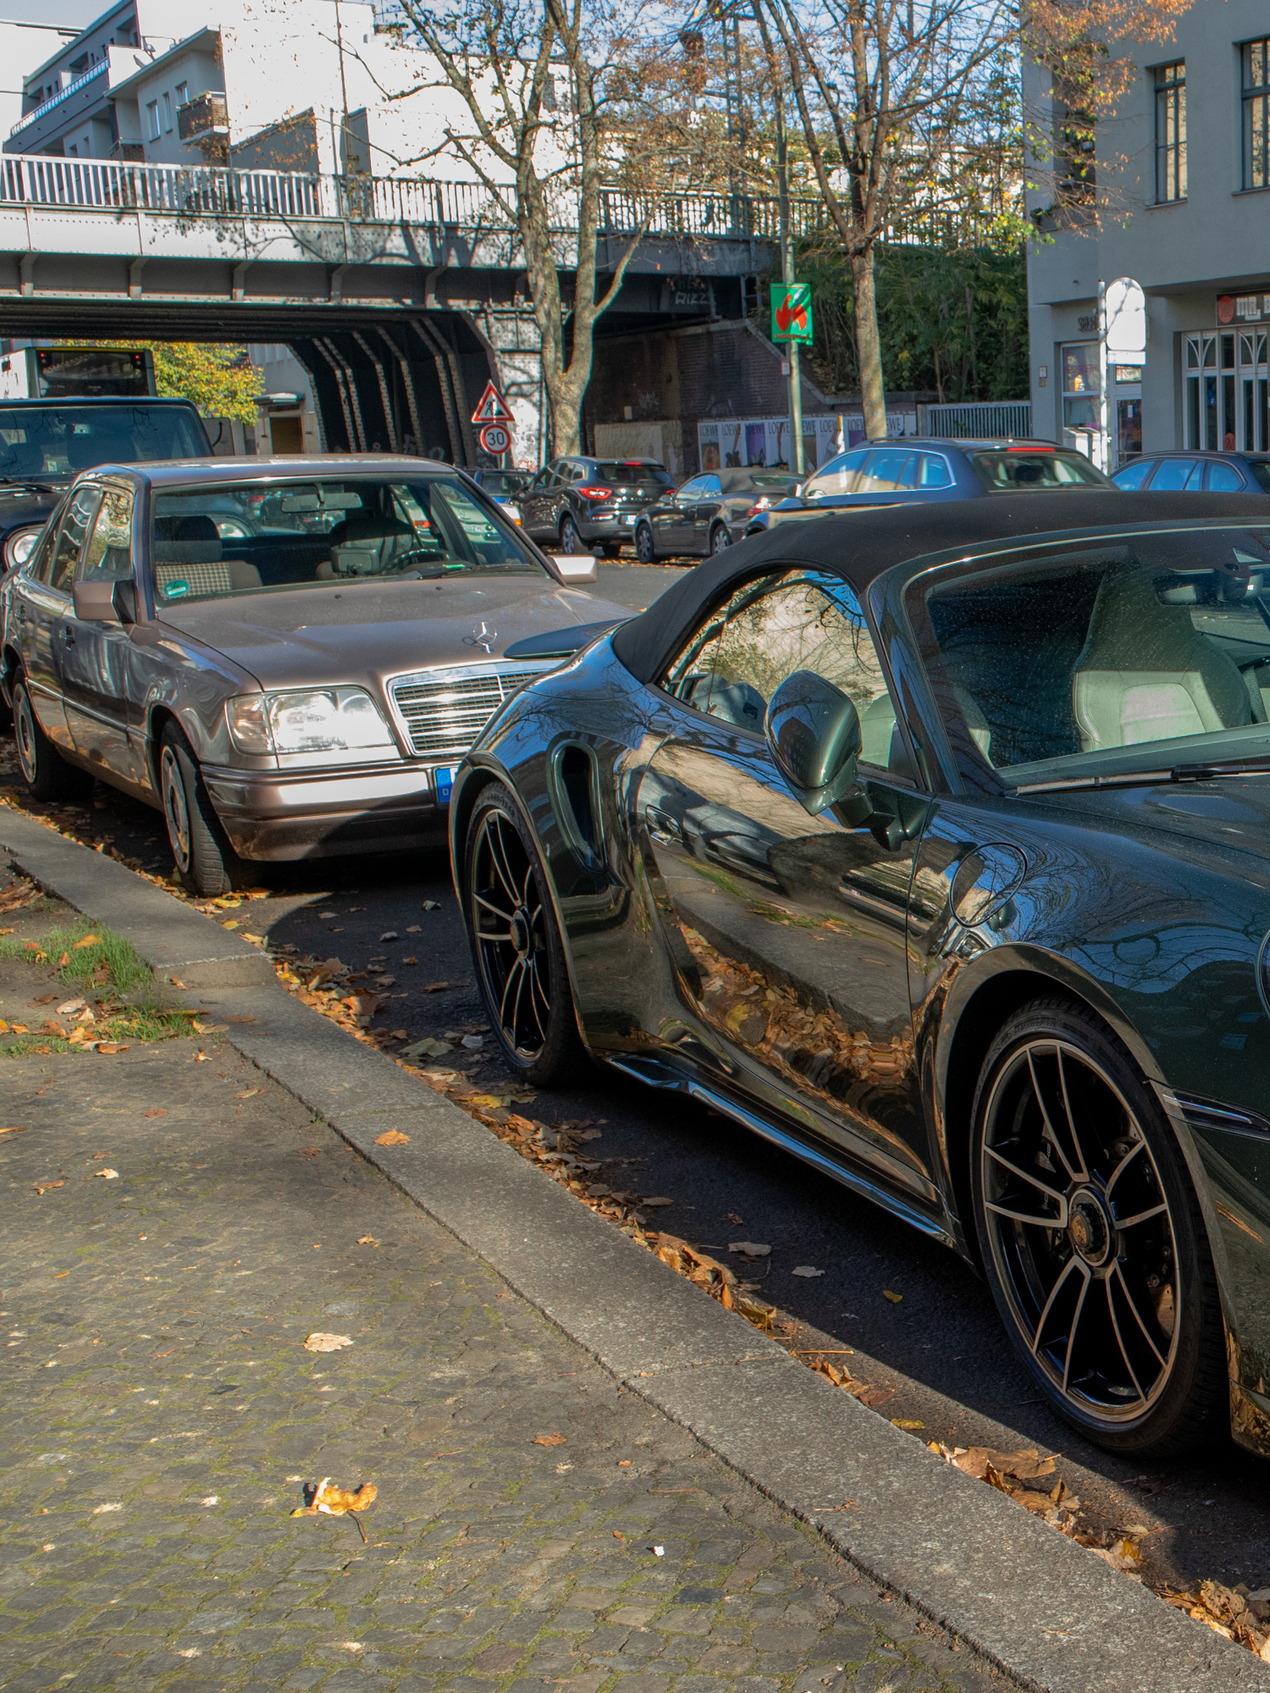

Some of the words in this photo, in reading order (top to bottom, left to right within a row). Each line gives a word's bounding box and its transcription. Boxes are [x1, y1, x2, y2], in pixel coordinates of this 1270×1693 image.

[700, 424, 719, 436] LOEWE
[486, 431, 505, 446] 30
[442, 788, 449, 796] D
